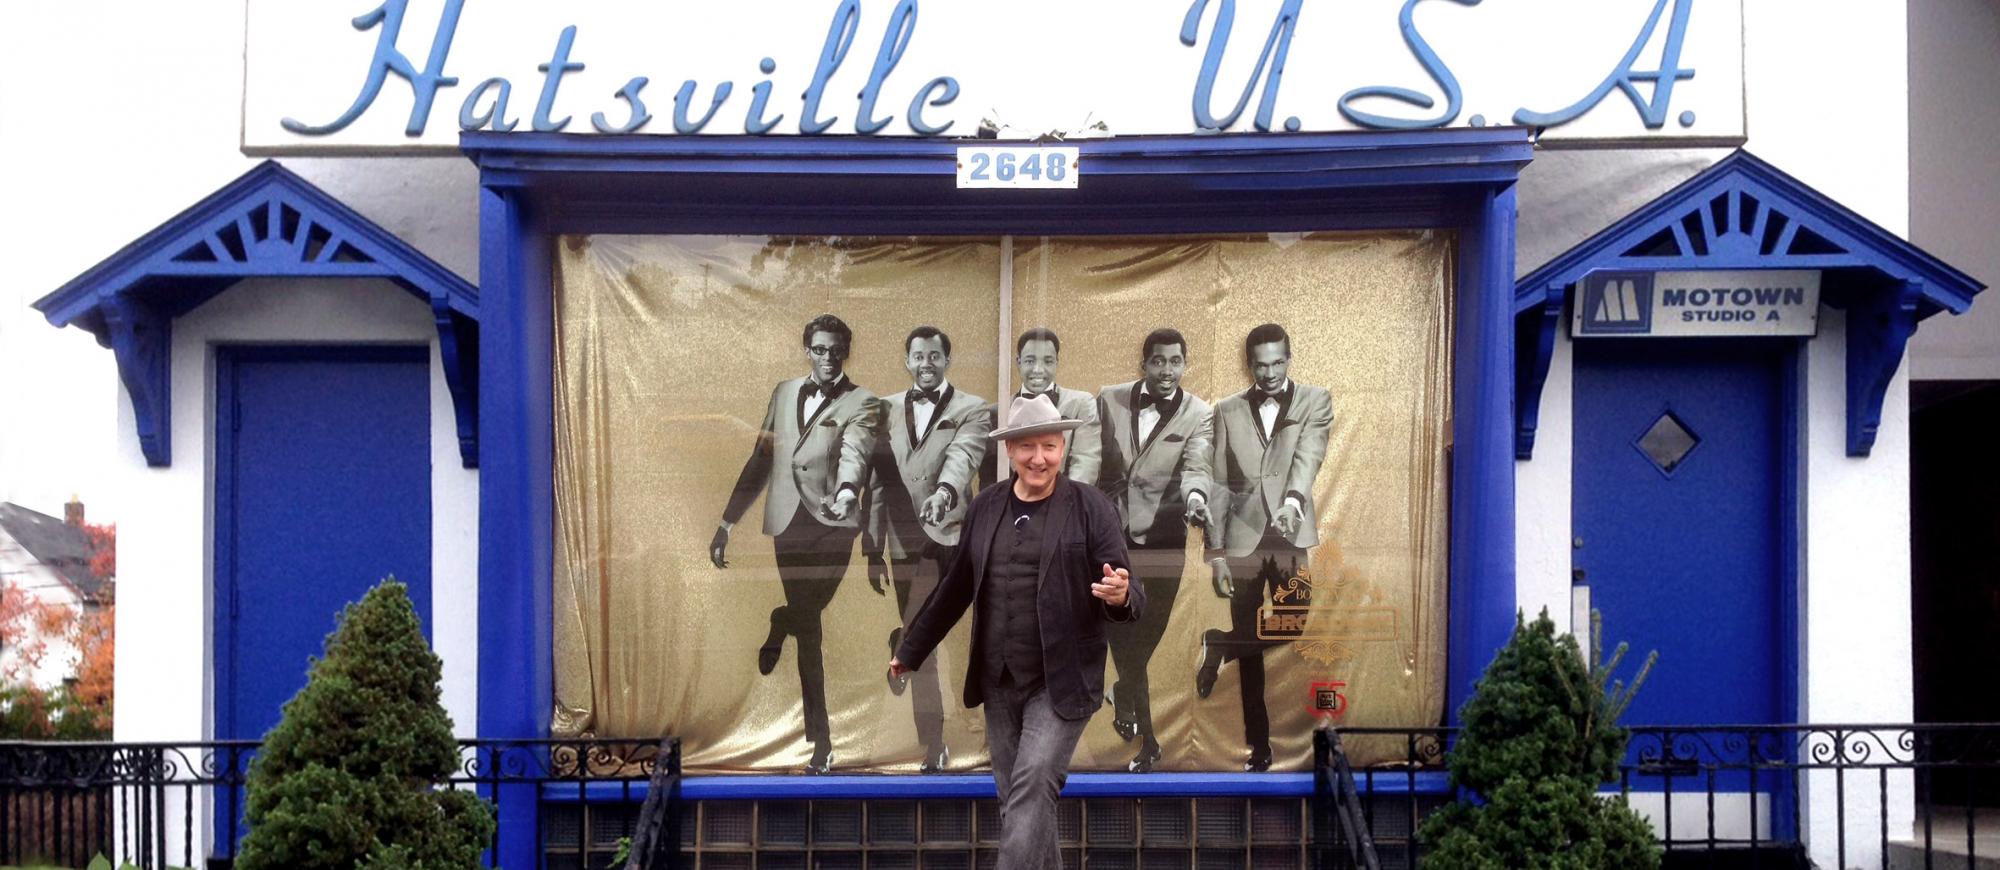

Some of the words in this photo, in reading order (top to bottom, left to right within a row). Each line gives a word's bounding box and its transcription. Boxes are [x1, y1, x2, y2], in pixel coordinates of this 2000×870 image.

[279, 0, 960, 137] Hatsville
[970, 152, 1066, 182] 2648
[1662, 287, 1804, 307] MOTOWN
[1682, 309, 1756, 323] STUDIO
[1766, 309, 1781, 322] A
